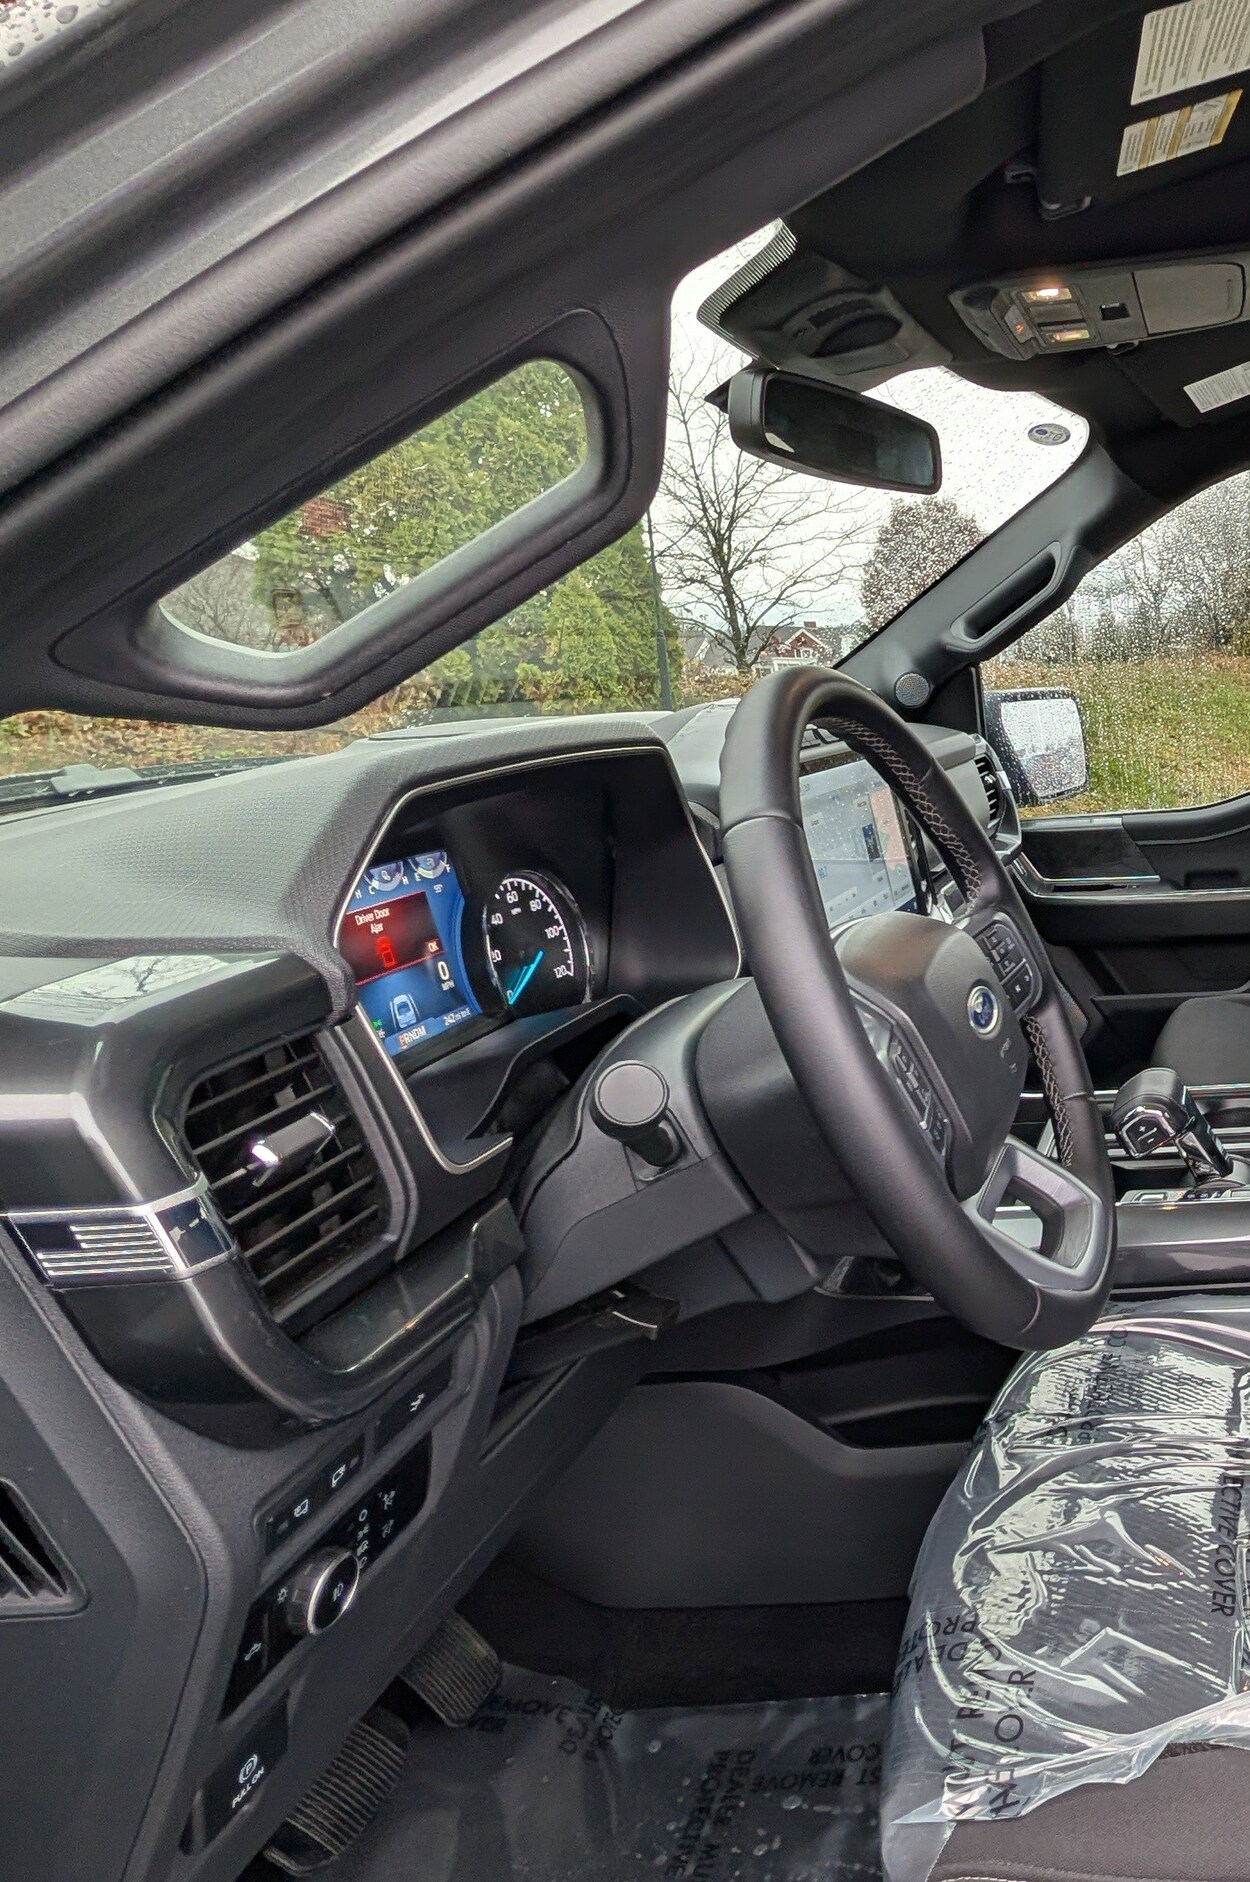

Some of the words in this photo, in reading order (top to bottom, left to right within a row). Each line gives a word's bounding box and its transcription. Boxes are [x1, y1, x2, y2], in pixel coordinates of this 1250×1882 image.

[506, 891, 519, 904] 60
[529, 898, 542, 912] 80
[354, 912, 375, 926] Driver
[373, 907, 391, 920] Door
[491, 912, 504, 926] 40
[370, 922, 385, 935] Ajar
[544, 925, 561, 940] 100
[427, 940, 440, 953] OK
[437, 960, 450, 981] 0
[553, 964, 569, 980] 120
[1210, 1544, 1237, 1618] COVER
[231, 1783, 252, 1809] PULL
[251, 1766, 265, 1784] ON
